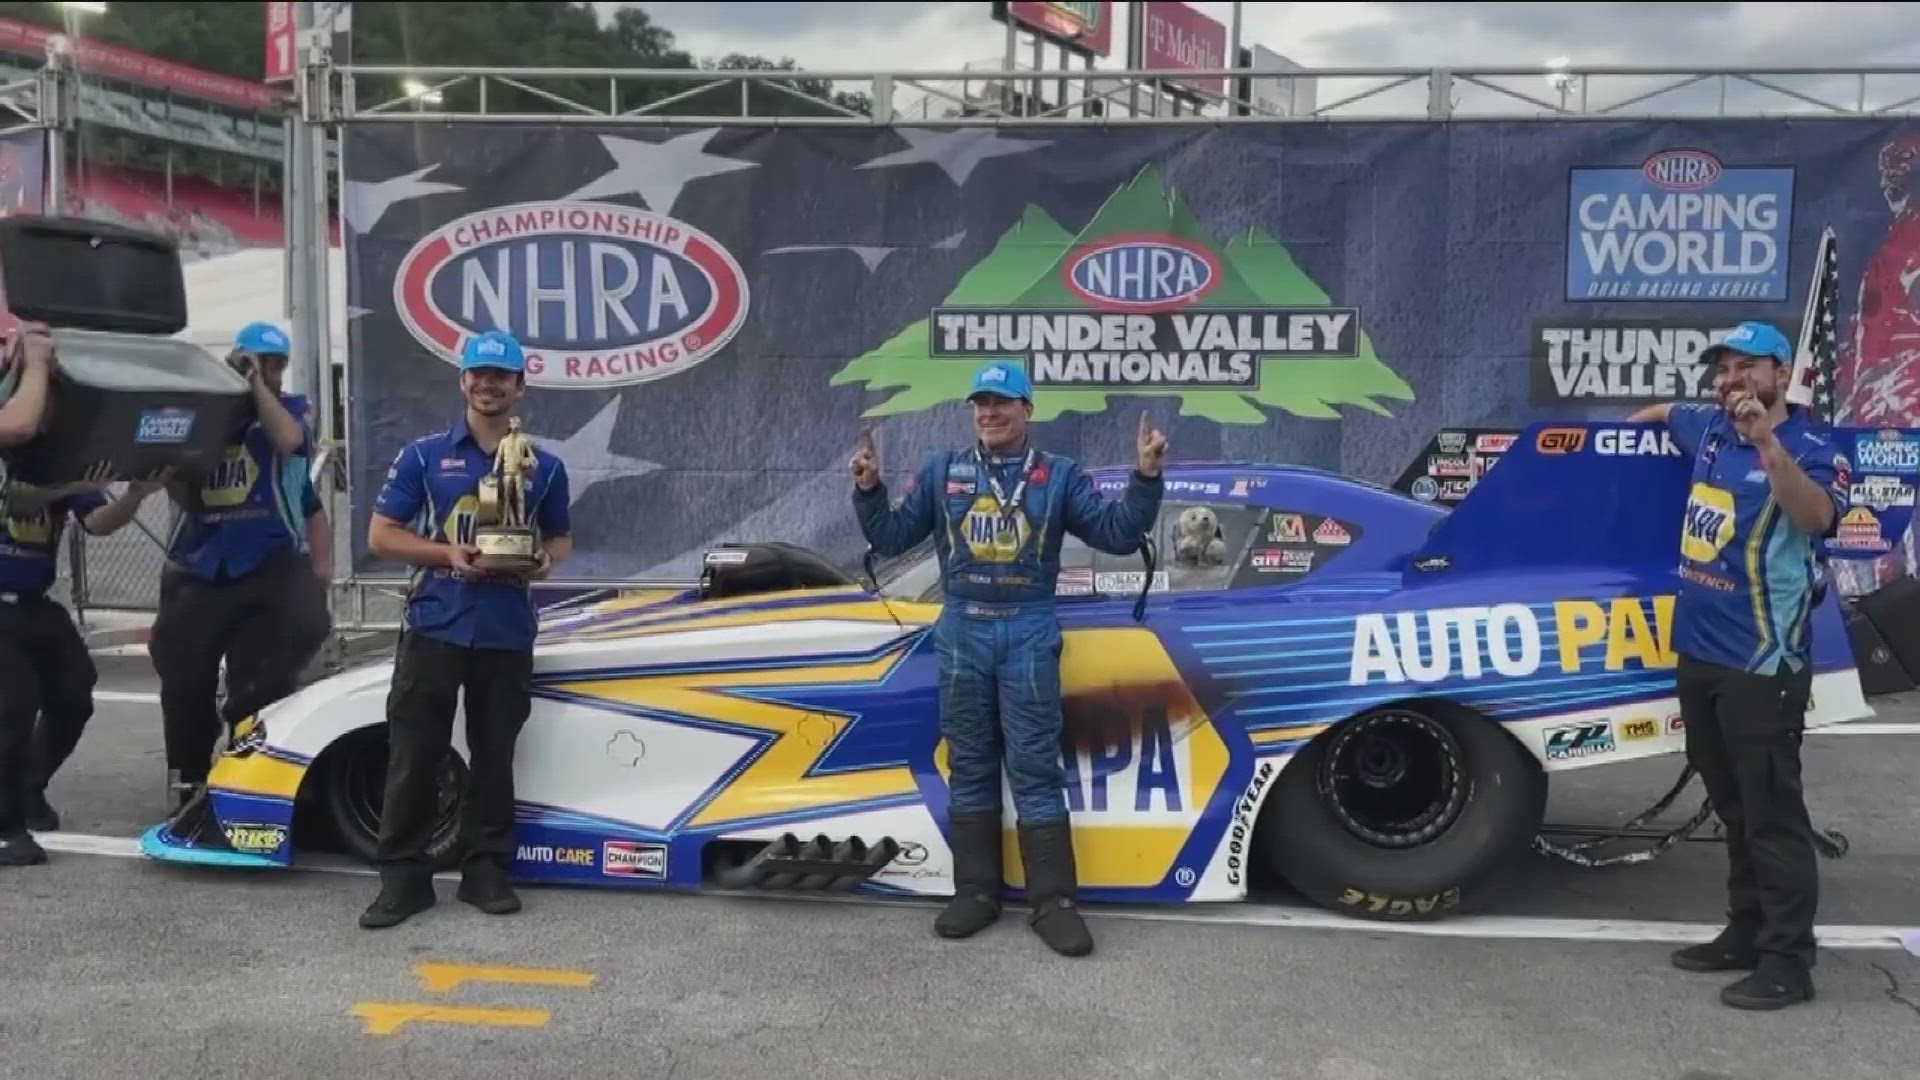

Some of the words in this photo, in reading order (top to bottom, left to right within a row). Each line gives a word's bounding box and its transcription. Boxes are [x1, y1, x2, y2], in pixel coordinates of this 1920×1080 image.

[1655, 157, 1713, 184] NHRA
[454, 209, 680, 248] CHAMPIONSHIP
[1578, 193, 1778, 232] CAMPING
[1580, 230, 1778, 275] WORLD
[461, 240, 690, 342] NHRA
[1087, 249, 1199, 299] NHRA
[1587, 280, 1631, 297] DRAG
[1636, 280, 1702, 297] RACING
[1708, 280, 1769, 297] SERIES
[938, 313, 1157, 352] THUNDER
[1171, 312, 1351, 352] VALLEY
[564, 341, 680, 379] RACING
[1034, 351, 1252, 383] NATIONALS
[1549, 363, 1710, 398] VALLEY
[1856, 440, 1919, 453] CAMPING
[1858, 450, 1919, 467] WORLD
[1350, 603, 1540, 686] AUTO
[1226, 761, 1275, 888] GOODYEAR
[517, 844, 553, 862] AUTO
[556, 847, 595, 866] CARE
[608, 852, 663, 868] CHAMPION
[1337, 886, 1461, 915] EAGLE
